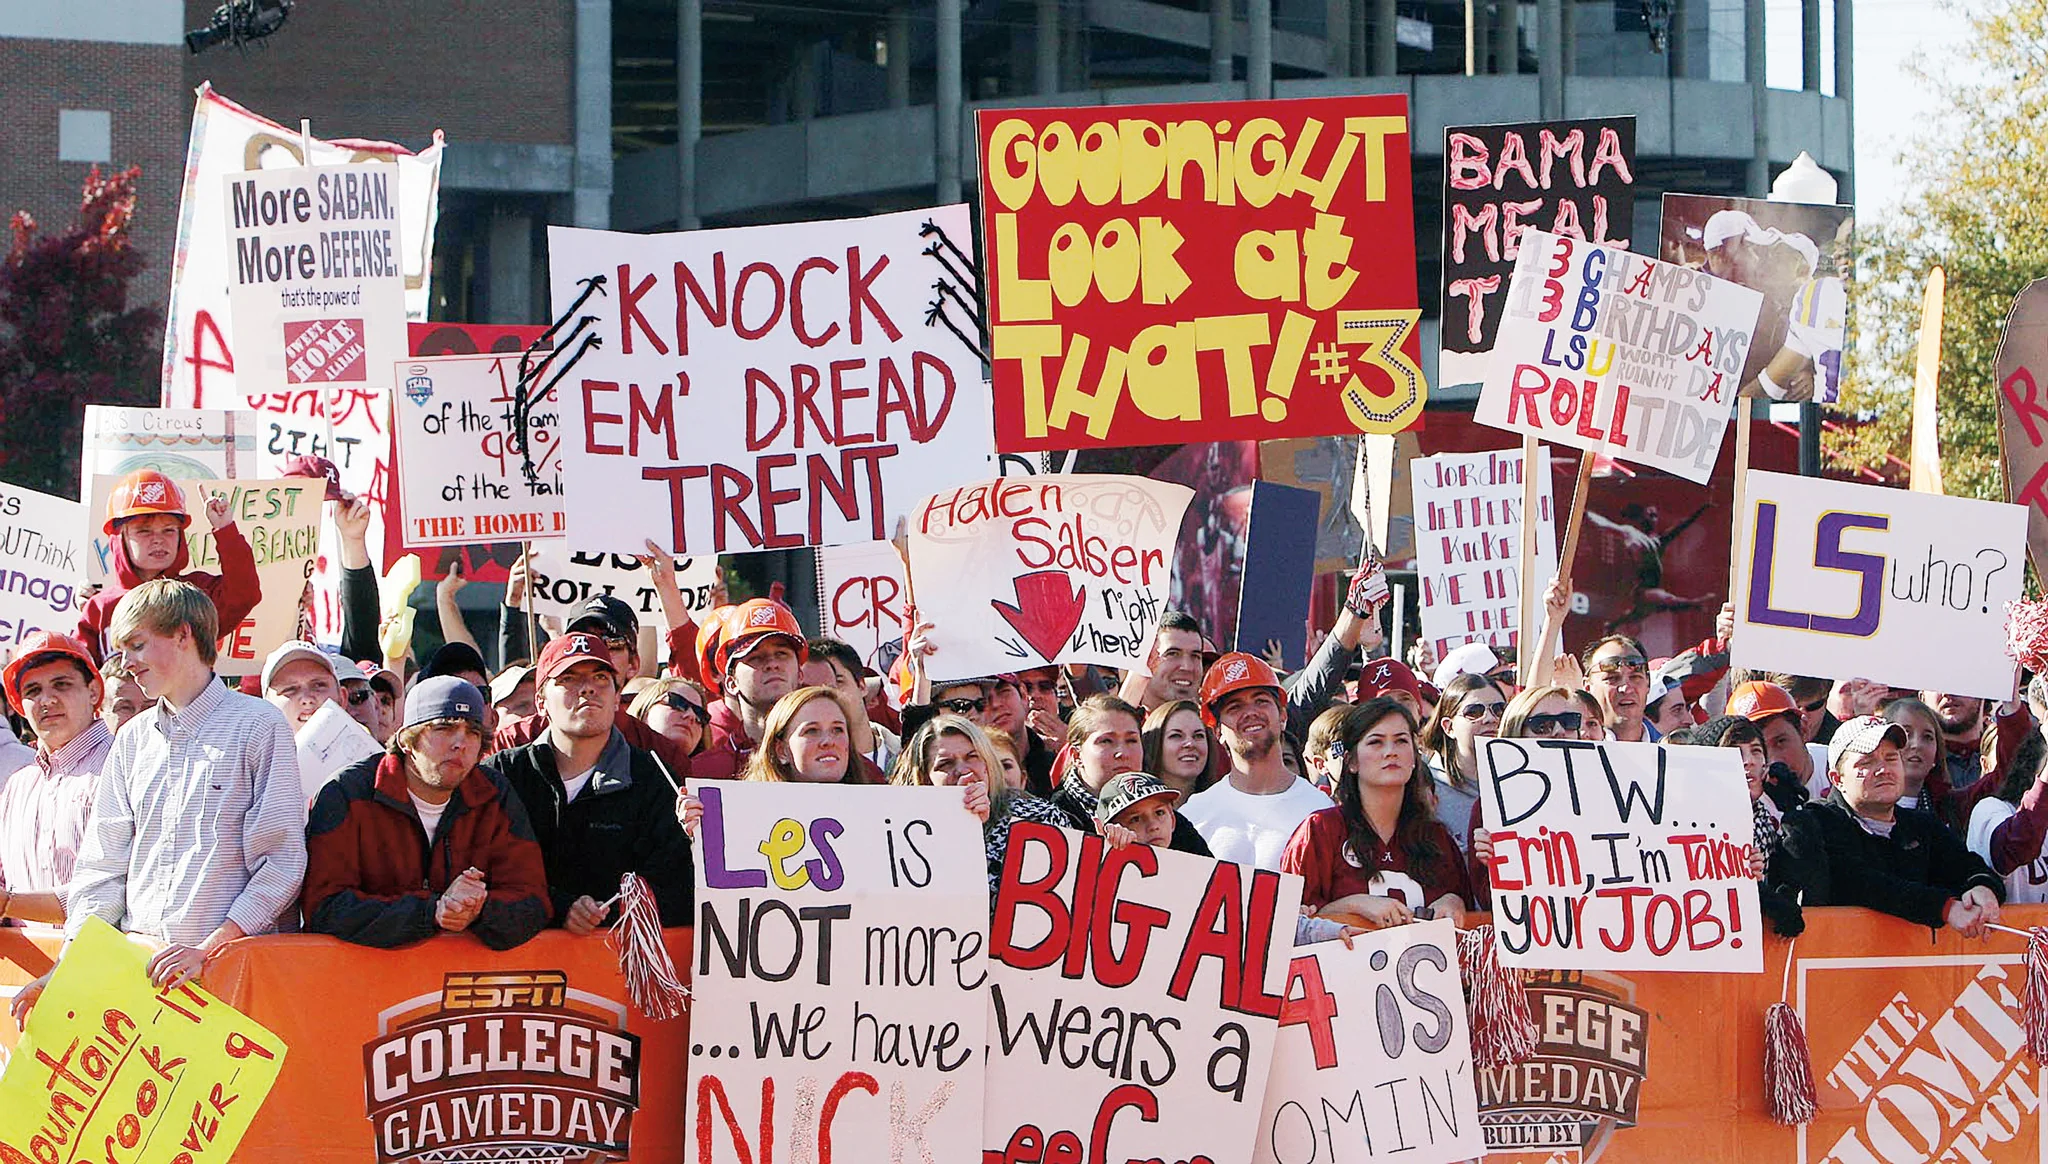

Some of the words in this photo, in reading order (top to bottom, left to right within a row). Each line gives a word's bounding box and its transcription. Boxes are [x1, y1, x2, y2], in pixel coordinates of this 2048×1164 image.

[1449, 127, 1634, 191] BAMA
[232, 180, 310, 228] More
[318, 172, 394, 220] SABAN.
[1451, 194, 1630, 264] MEAL
[237, 236, 315, 284] More
[320, 230, 398, 278] DEFENSE.
[995, 212, 1192, 321] LOOK
[1233, 212, 1360, 311] at
[1523, 234, 1573, 278] 13
[1582, 248, 1711, 312] CHAMPS
[282, 286, 304, 307] that's
[307, 286, 321, 306] the
[323, 290, 350, 311] power
[352, 285, 360, 305] of
[617, 246, 903, 356] KNOCK
[1510, 277, 1564, 322] 13
[1571, 286, 1748, 375] BIRTHDAYS
[286, 320, 326, 359] SWEET
[288, 320, 356, 383] HOME
[325, 343, 364, 381] ALABAMA
[1309, 308, 1428, 435] #3
[1541, 328, 1616, 377] LSU
[423, 402, 452, 434] of
[457, 401, 492, 431] the
[581, 372, 690, 460] EM'
[744, 351, 956, 451] DREAD
[1507, 364, 1630, 447] ROLL
[1629, 394, 1722, 470] TIDE
[1686, 366, 1737, 406] DAY
[142, 410, 203, 431] Circus
[442, 475, 465, 500] of
[472, 474, 510, 499] the
[642, 445, 898, 553] TRENT
[921, 477, 1063, 534] Halen
[252, 525, 317, 567] BEACH
[414, 517, 464, 537] THE
[474, 513, 544, 534] HOME
[1012, 517, 1162, 586] Salser
[1424, 573, 1471, 607] ME
[1745, 499, 1891, 638] LS
[1892, 544, 2008, 614] who?
[1103, 588, 1160, 644] right
[1459, 606, 1519, 634] THE
[698, 787, 844, 892] Les
[884, 818, 932, 888] is
[1488, 826, 1596, 893] Erin,
[1602, 832, 1670, 885] I'm
[699, 898, 851, 985] NOT
[865, 926, 987, 991] more
[989, 821, 1171, 989] BIG
[1167, 861, 1284, 1021] AL
[1596, 887, 1743, 957] JOB!
[444, 974, 566, 1009] ESPN
[372, 1019, 632, 1101] COLLEGE
[852, 1001, 972, 1072] have
[990, 984, 1181, 1087] wears
[1206, 1021, 1250, 1102] a
[1825, 991, 1928, 1103] THE
[75, 1046, 188, 1164] rook
[1478, 1063, 1634, 1114] MEDAY
[384, 1093, 626, 1156] GAMEDAY
[1483, 1127, 1542, 1145] BUILT
[1549, 1125, 1574, 1142] BY
